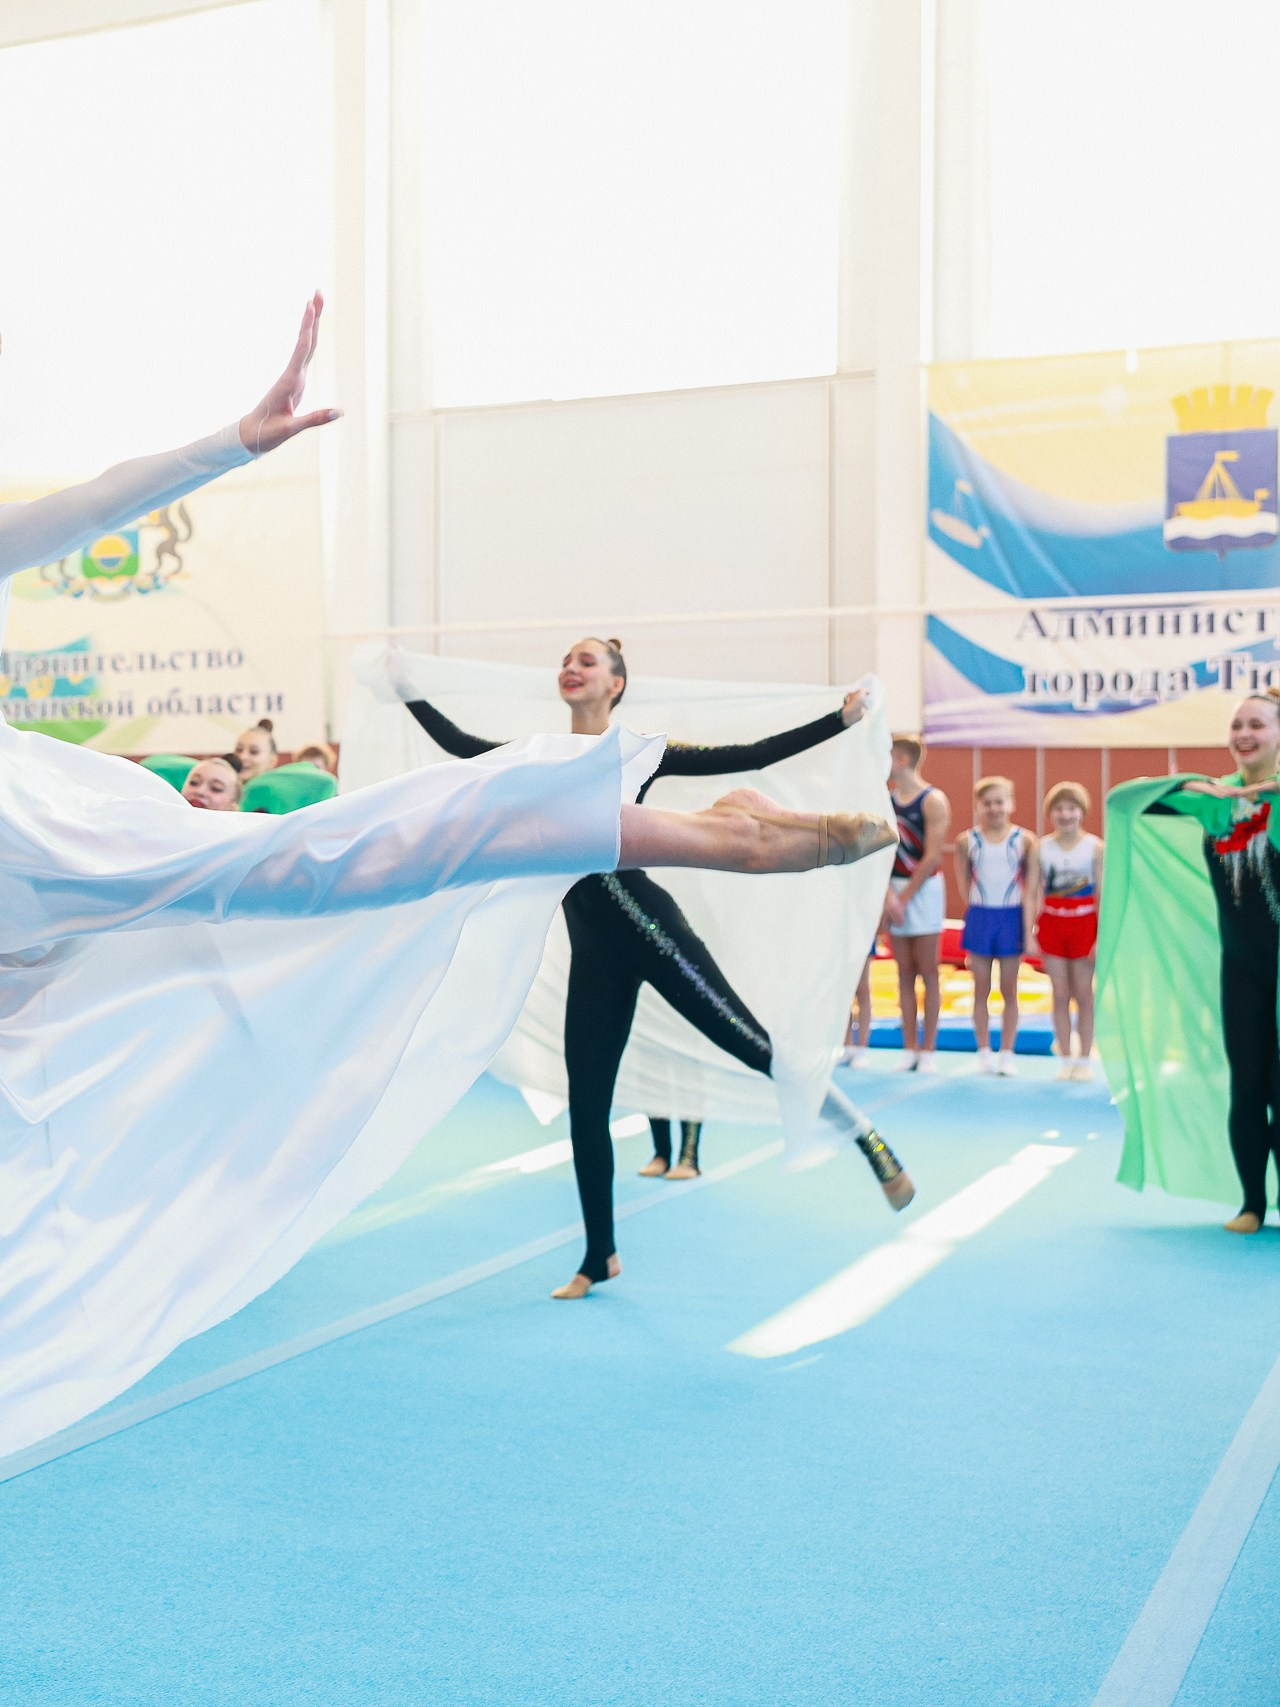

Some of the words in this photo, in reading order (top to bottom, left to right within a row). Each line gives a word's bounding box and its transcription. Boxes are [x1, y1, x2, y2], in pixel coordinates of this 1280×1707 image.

[1017, 607, 1275, 641] Админист
[147, 688, 285, 717] области
[1024, 668, 1189, 704] города
